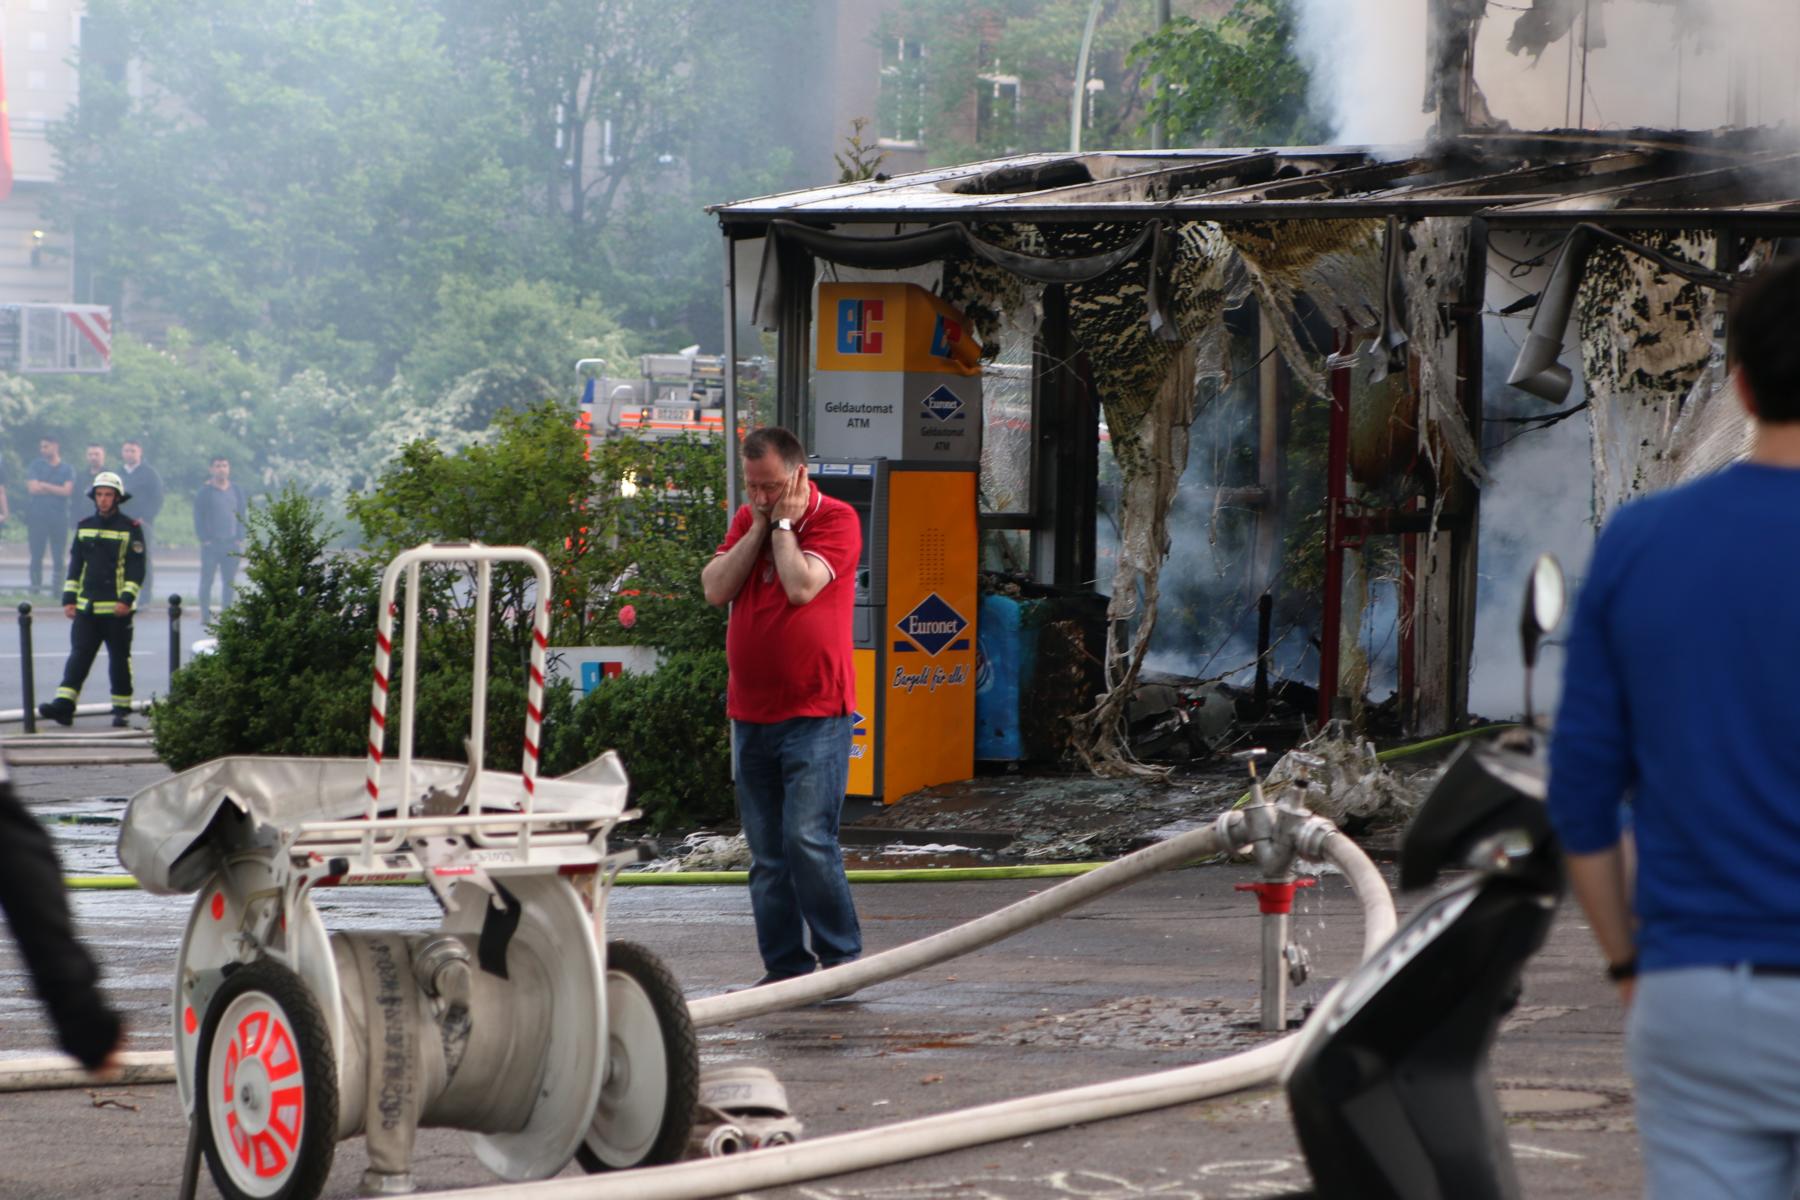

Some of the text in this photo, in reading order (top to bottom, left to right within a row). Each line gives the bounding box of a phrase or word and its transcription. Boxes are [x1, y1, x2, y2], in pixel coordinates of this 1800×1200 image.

[824, 401, 893, 414] Geldautomat
[928, 397, 957, 409] Euronet
[847, 418, 870, 429] ATM
[933, 440, 950, 450] ATM
[908, 615, 958, 634] Euronet
[892, 663, 970, 694] Bargeld für alle!
